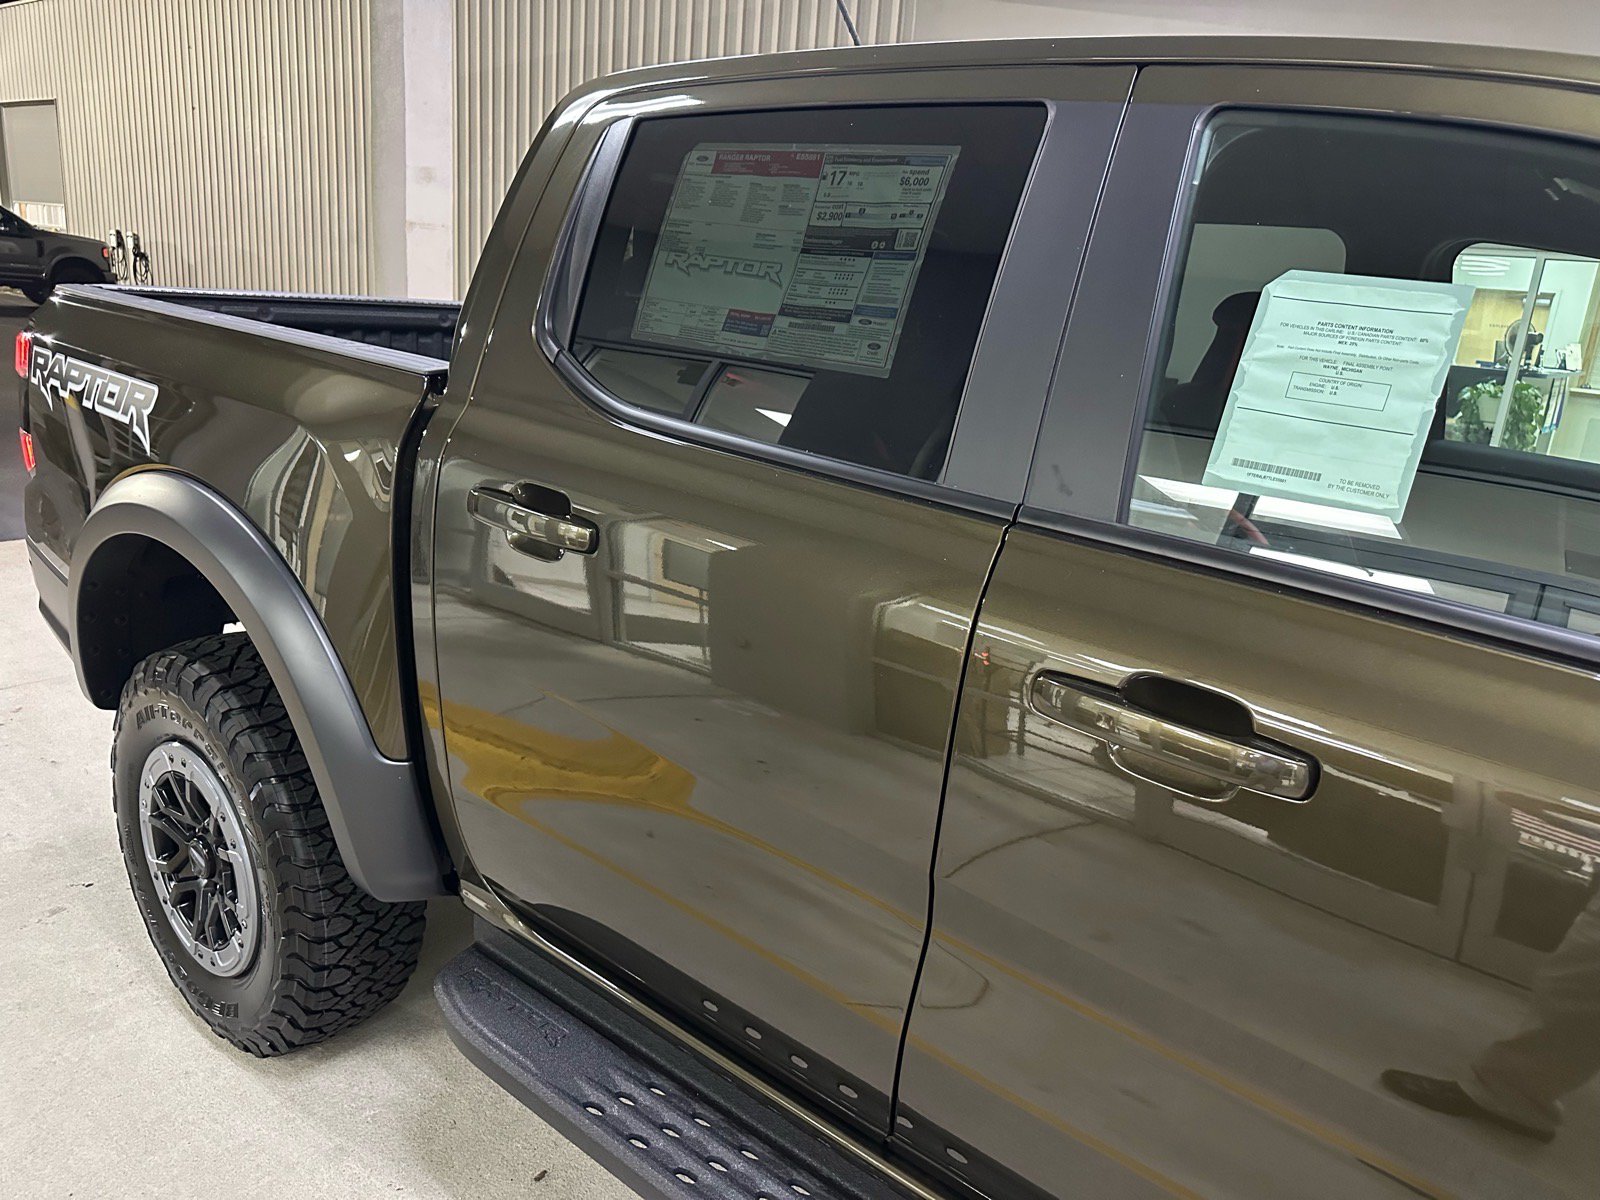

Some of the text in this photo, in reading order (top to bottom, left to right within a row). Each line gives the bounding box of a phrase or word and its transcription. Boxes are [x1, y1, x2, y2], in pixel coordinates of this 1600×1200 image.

[744, 154, 771, 162] RAPTOR
[830, 170, 848, 186] 17
[899, 176, 930, 187] $6,000
[816, 212, 843, 221] $2,900
[664, 252, 784, 290] RAPTOR
[1358, 325, 1394, 334] INFORMATION
[1341, 366, 1363, 374] MICHIGAN
[30, 344, 159, 457] RAPTOR
[1354, 480, 1381, 490] REMOVED
[1346, 486, 1375, 496] CUSTOMER
[1375, 491, 1390, 499] ONLY
